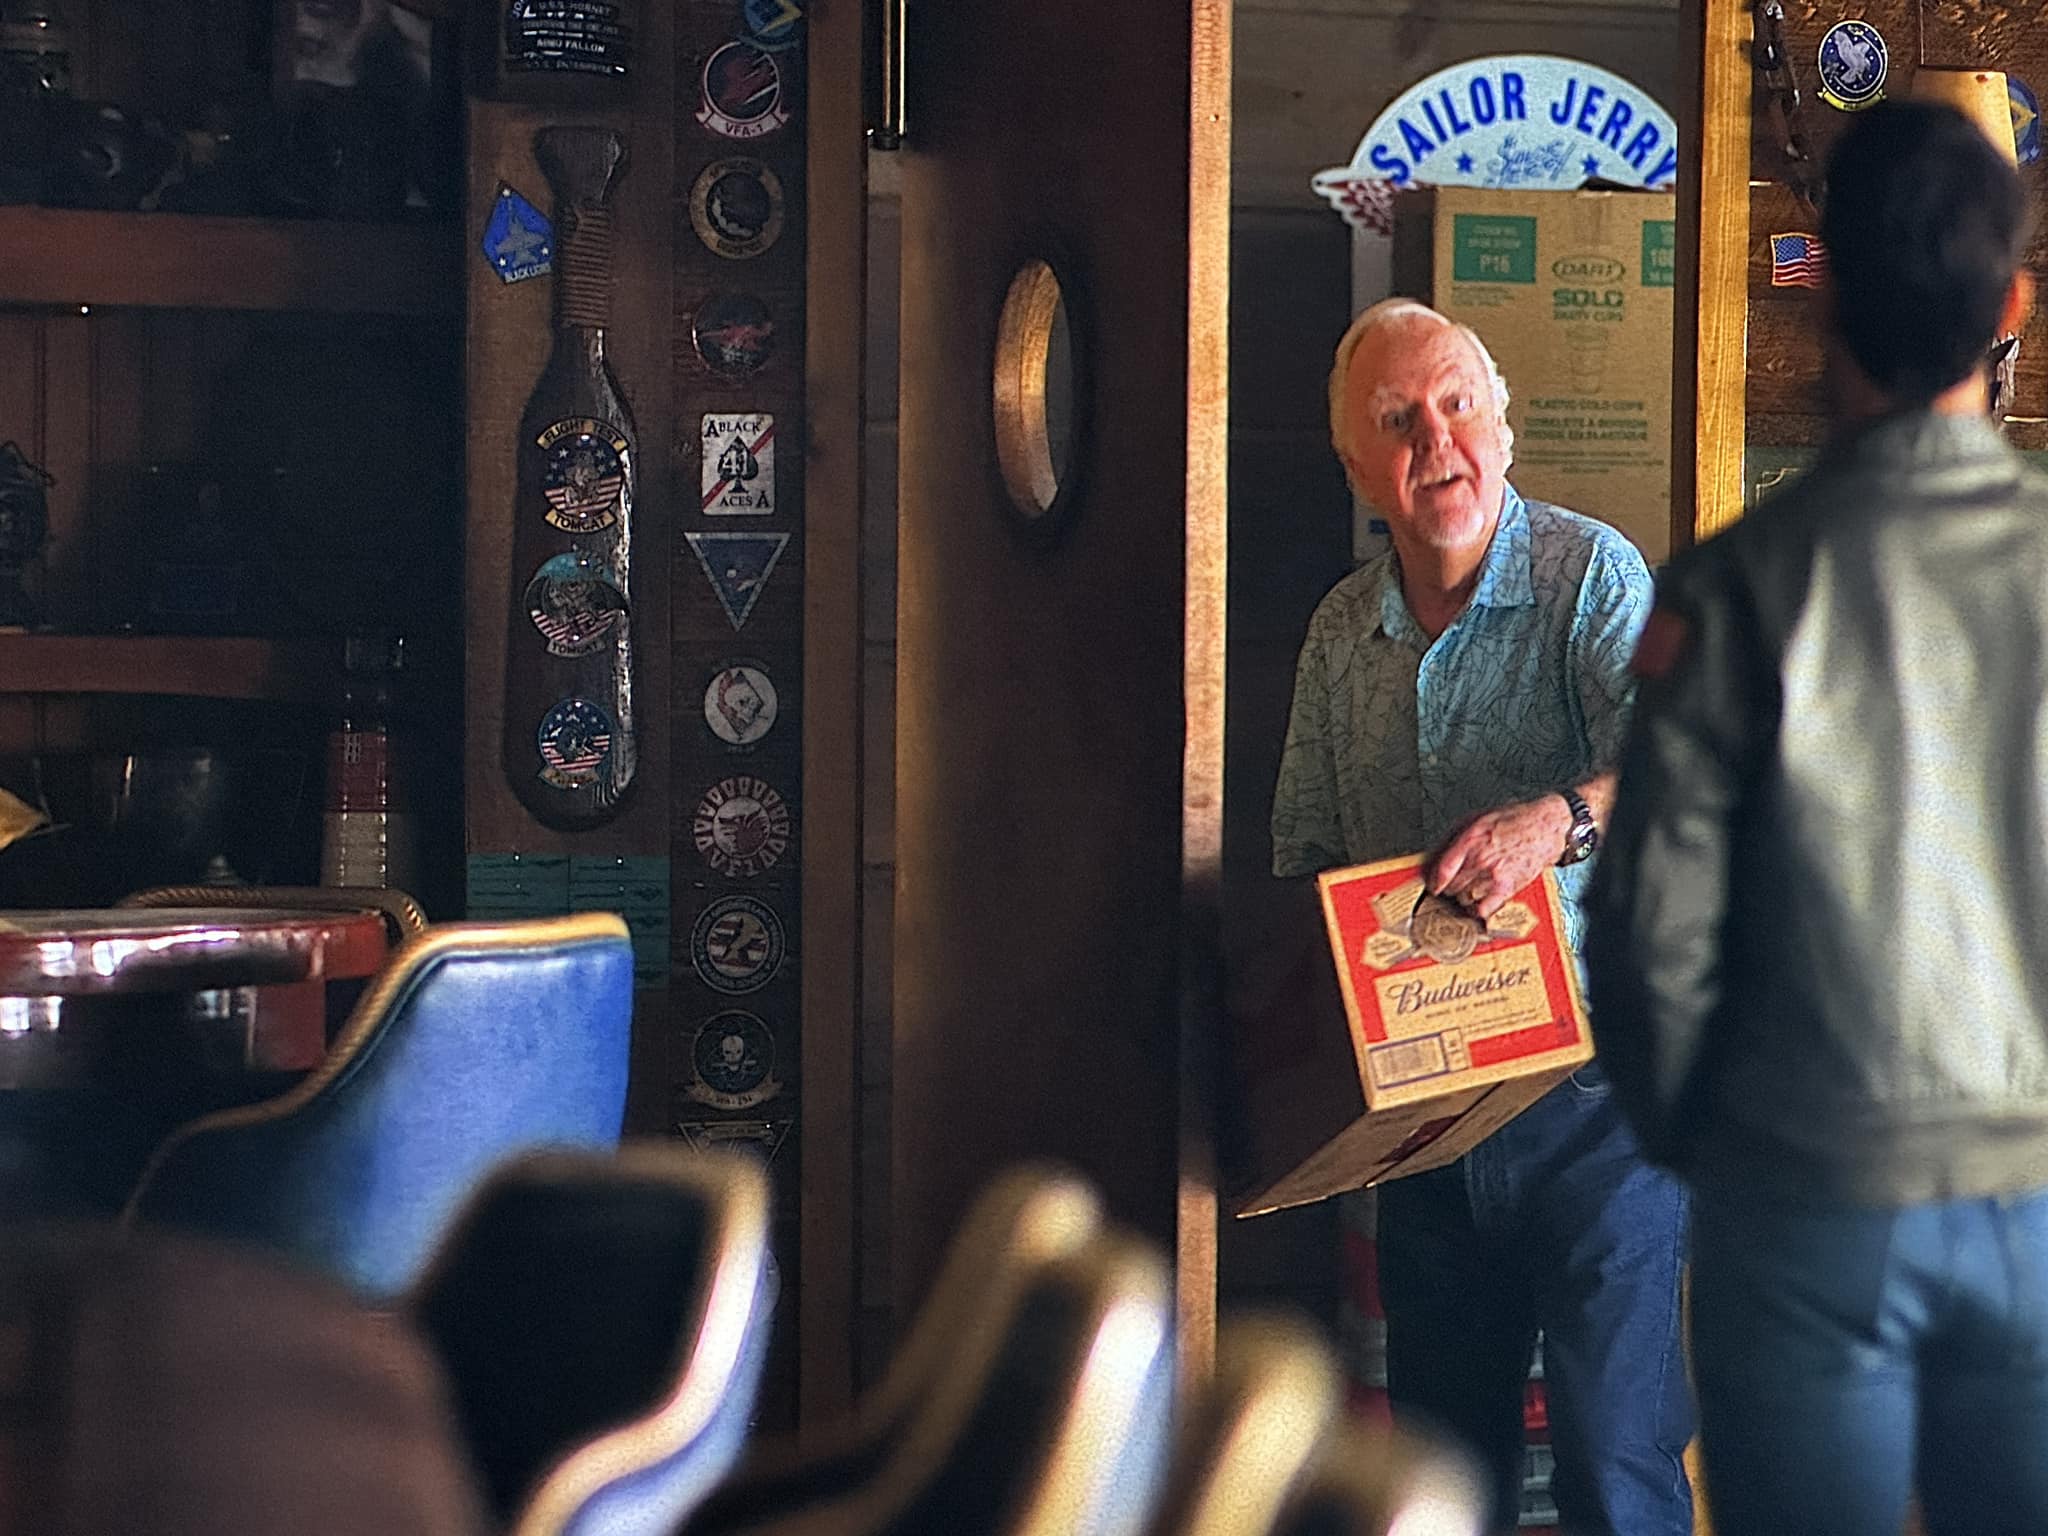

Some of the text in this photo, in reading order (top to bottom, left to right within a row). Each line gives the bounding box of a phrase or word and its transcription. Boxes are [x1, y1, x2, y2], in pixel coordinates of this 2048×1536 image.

[564, 40, 606, 53] FALLON
[1370, 72, 1528, 187] SAILOR
[1549, 78, 1676, 185] JERRY
[503, 269, 531, 284] BLACK
[1561, 263, 1613, 277] DART
[1552, 287, 1624, 307] SOLO
[544, 420, 619, 444] FLIGHT TEST
[719, 422, 760, 434] BLACK
[720, 496, 753, 506] ACES
[554, 514, 605, 530] TOMCAT
[1387, 967, 1531, 1016] Budweiser
